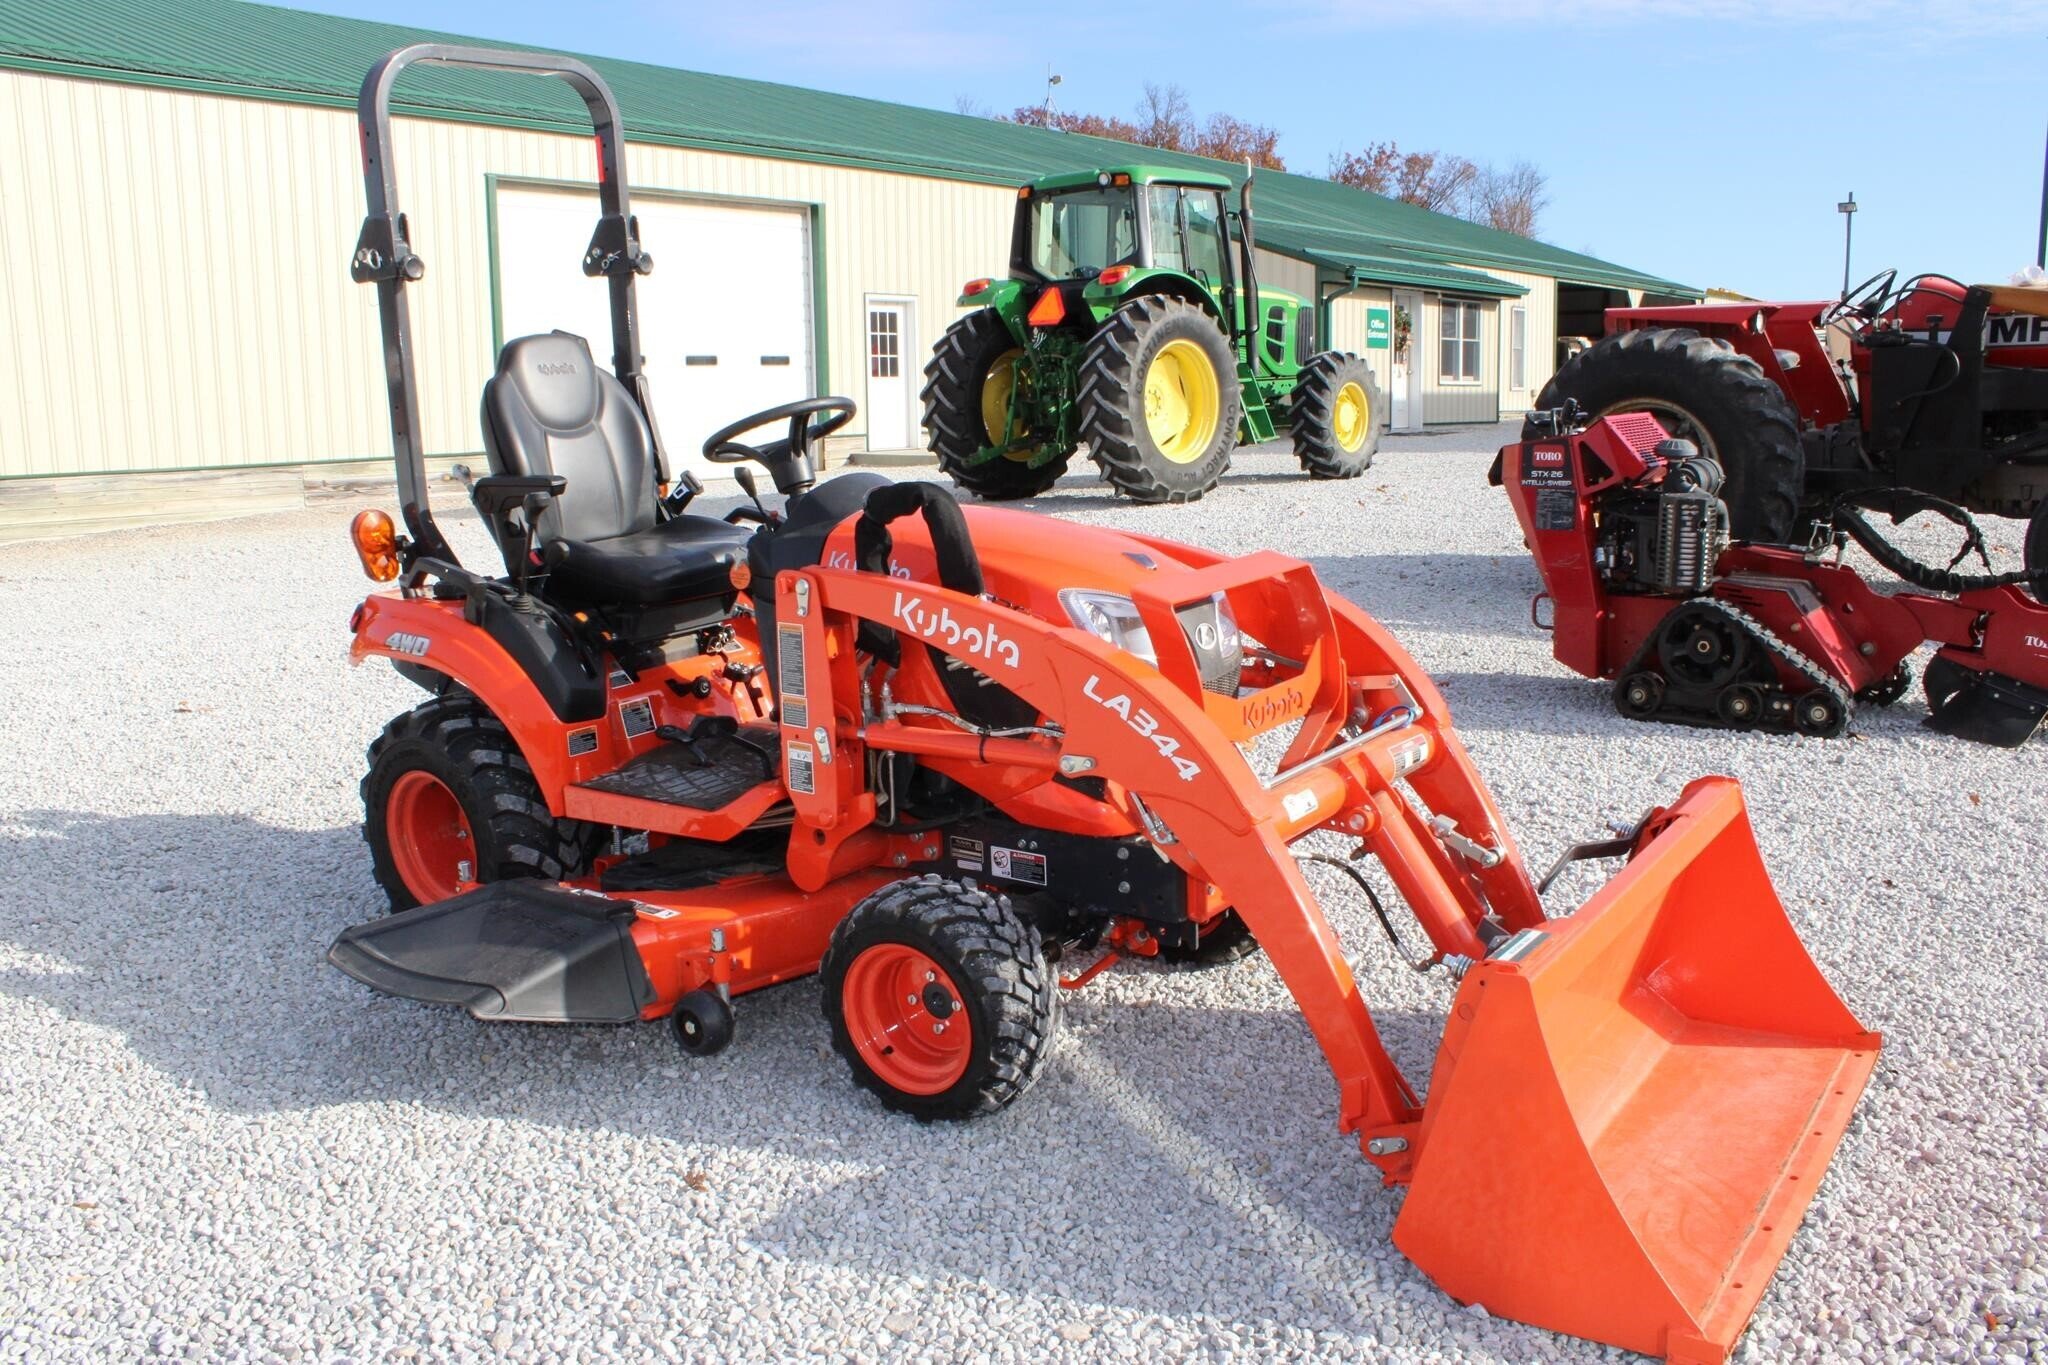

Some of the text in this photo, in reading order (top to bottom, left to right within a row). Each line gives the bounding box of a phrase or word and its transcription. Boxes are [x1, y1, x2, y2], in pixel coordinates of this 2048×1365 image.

[1367, 329, 1388, 339] Entrance
[1371, 319, 1385, 328] Office
[1201, 404, 1237, 478] CONTRACT
[1534, 451, 1562, 461] TORO
[829, 551, 911, 580] Kuta
[385, 631, 431, 656] 4WD
[893, 591, 1019, 668] Kubota
[1243, 687, 1303, 729] Kubota
[1083, 674, 1201, 781] LA344
